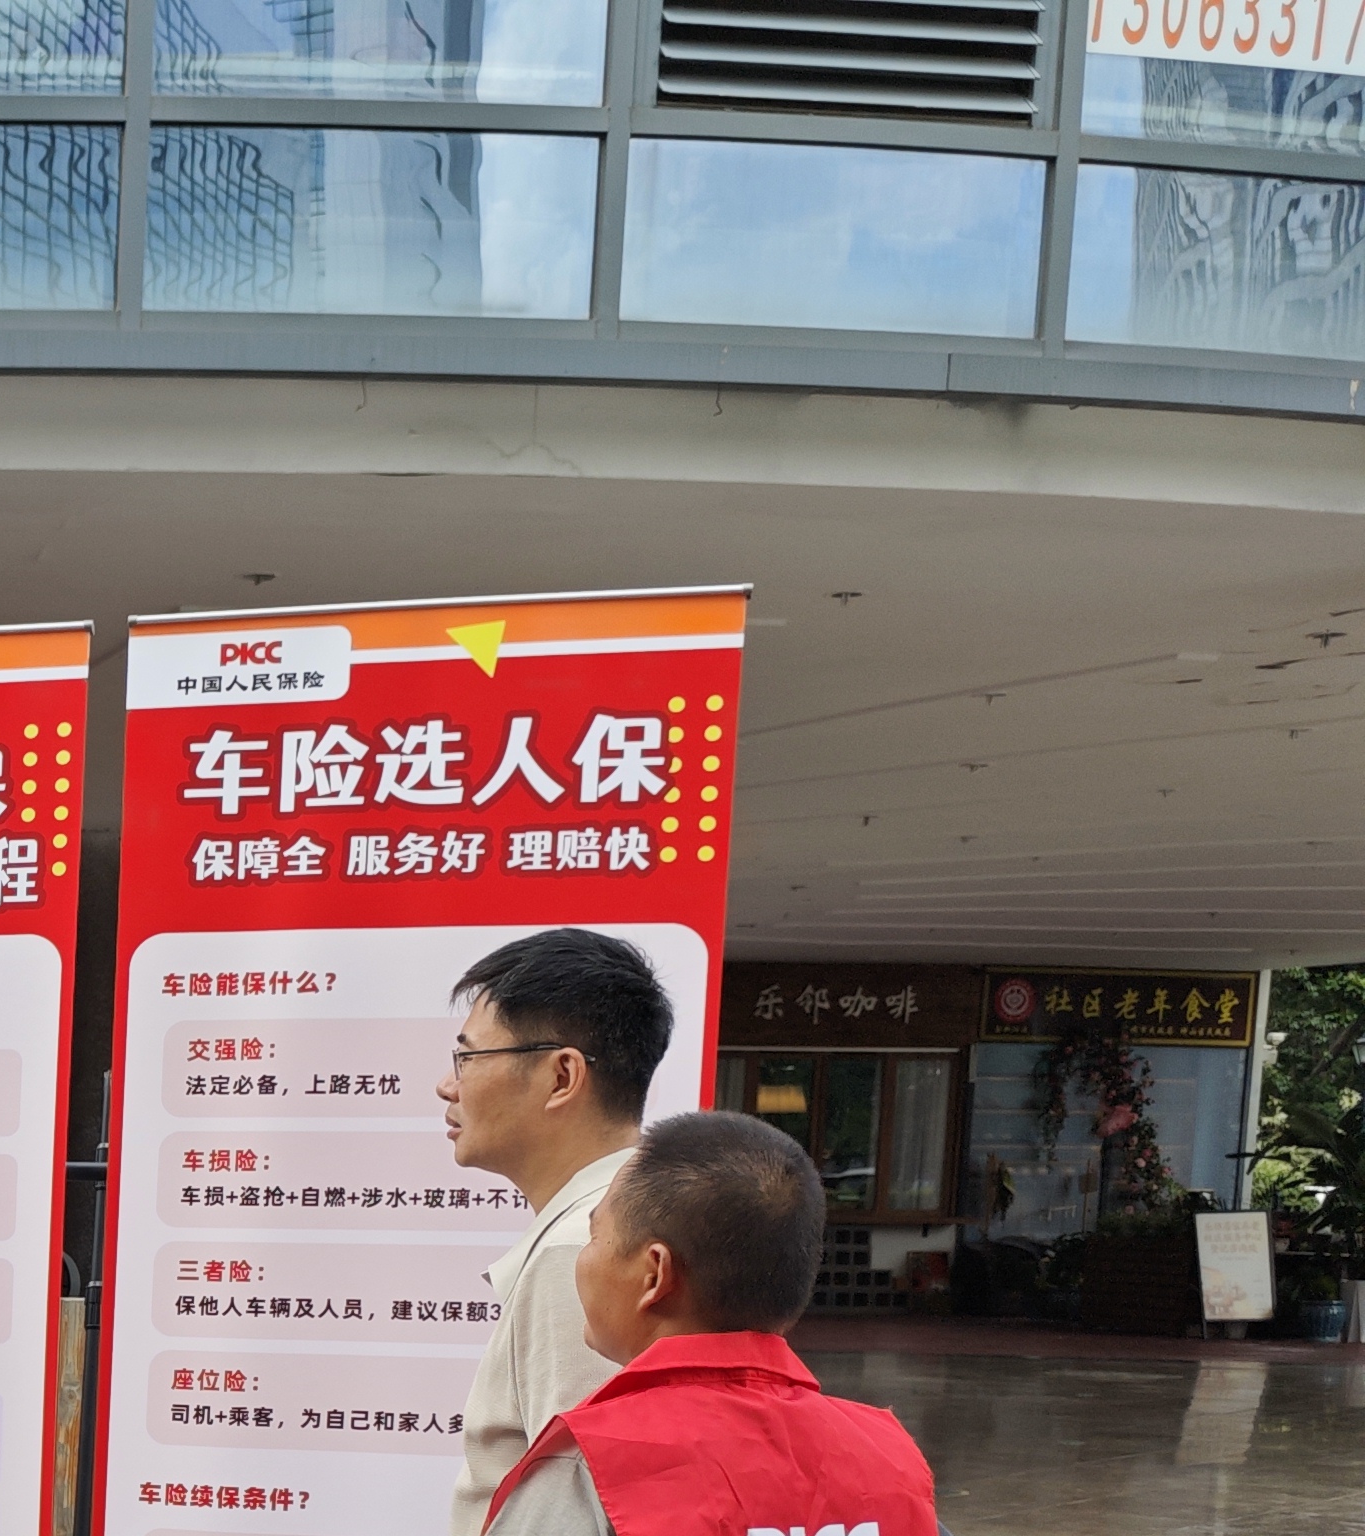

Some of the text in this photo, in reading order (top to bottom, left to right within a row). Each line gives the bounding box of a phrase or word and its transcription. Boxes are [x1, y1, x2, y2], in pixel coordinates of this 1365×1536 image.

[220, 641, 282, 666] PICC
[177, 671, 325, 695] 中国人民保险
[184, 714, 669, 815] 车险选人保
[192, 826, 652, 881] 保障全 服务好 理赔快
[162, 971, 337, 997] 车险能保什么？
[753, 984, 919, 1025] 乐邻咖啡
[1044, 986, 1240, 1024] 社区老年食堂
[186, 1037, 276, 1061] 交强险：
[184, 1073, 401, 1097] 法定必备，上路无忧
[182, 1149, 271, 1173] 车损险：
[176, 1259, 266, 1283] 三者险：
[171, 1368, 260, 1393] 座位险：
[139, 1482, 311, 1511] 车险续保条件？
